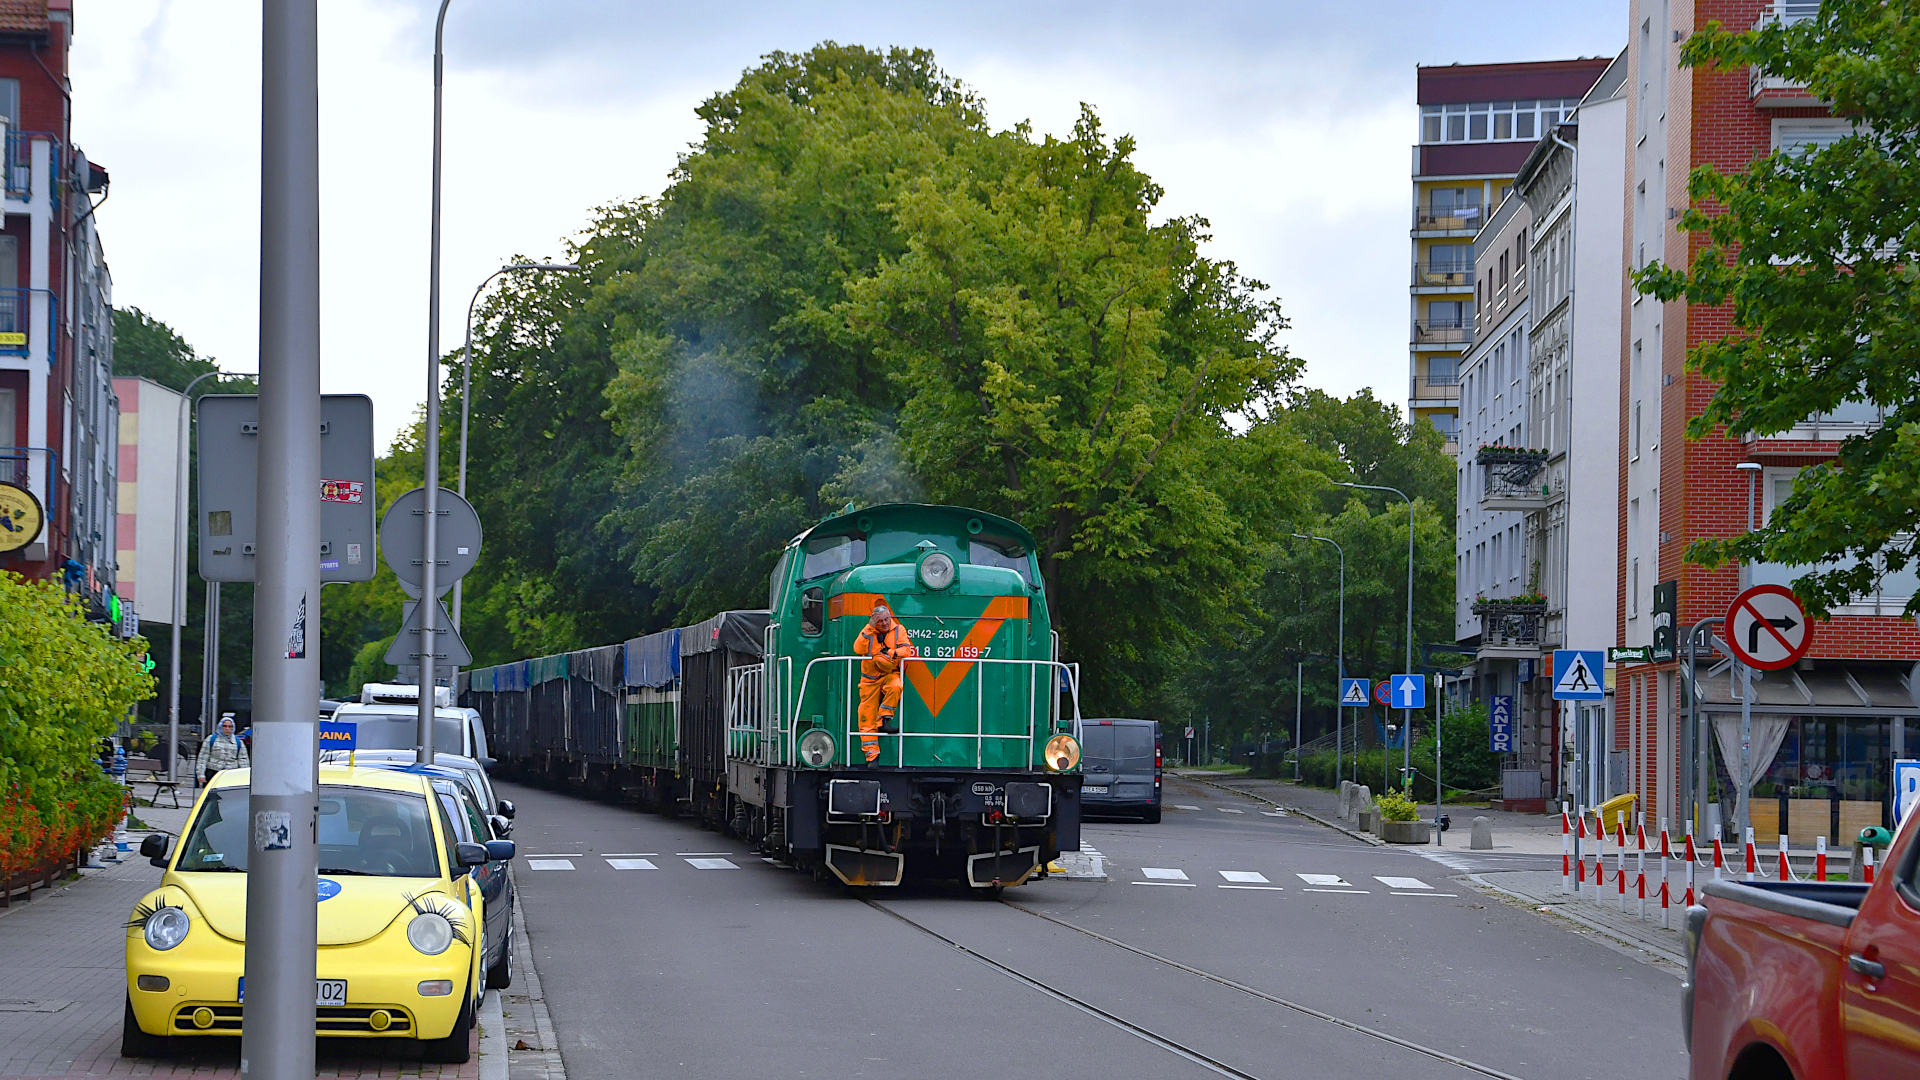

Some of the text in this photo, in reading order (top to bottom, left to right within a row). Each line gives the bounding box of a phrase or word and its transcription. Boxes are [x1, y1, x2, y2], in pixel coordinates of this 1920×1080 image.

[924, 646, 931, 657] 8
[937, 646, 956, 657] 621
[959, 647, 992, 658] 159-7
[1494, 696, 1509, 752] KANTOR
